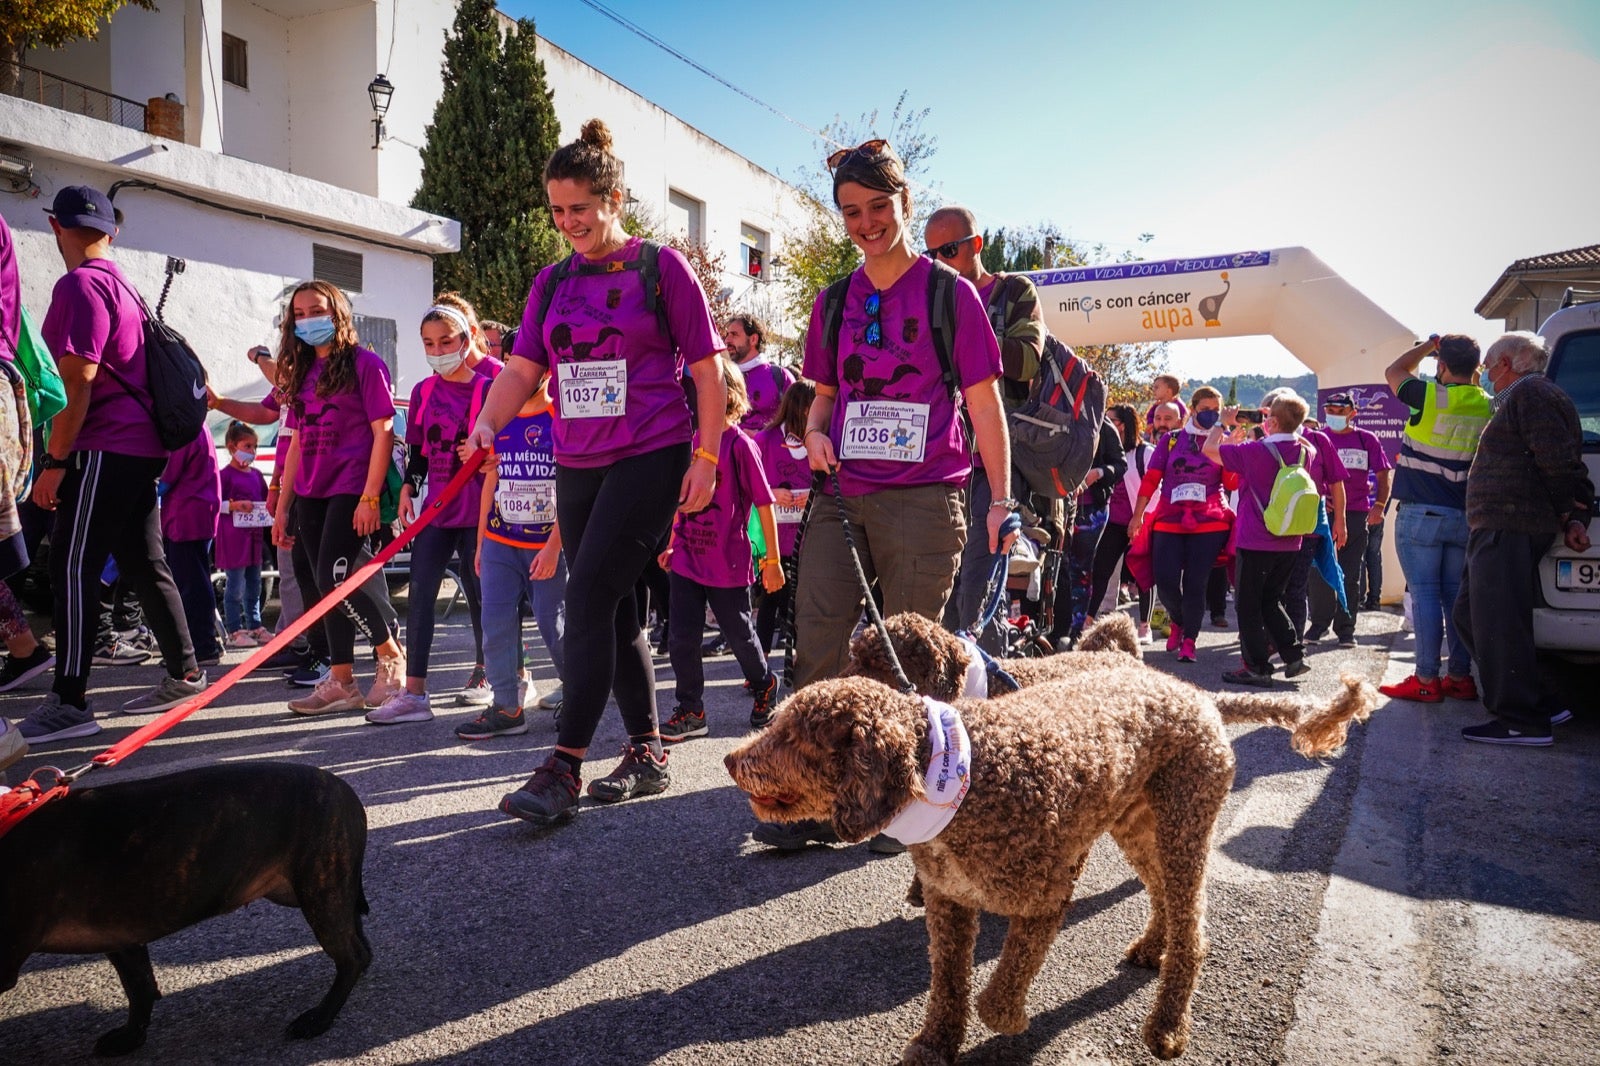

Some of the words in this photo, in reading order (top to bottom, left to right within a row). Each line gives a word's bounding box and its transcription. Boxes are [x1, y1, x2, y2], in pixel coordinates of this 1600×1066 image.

[1095, 268, 1123, 279] VIDA
[1106, 296, 1133, 308] con
[1138, 291, 1191, 307] cáncer
[1142, 307, 1193, 333] aupa
[570, 365, 579, 378] V
[565, 387, 599, 403] 1037
[860, 403, 870, 417] V
[1358, 418, 1387, 426] leucemia
[849, 427, 889, 443] 1036
[525, 464, 557, 478] VIDA
[503, 499, 531, 512] 1084
[238, 513, 254, 522] 752
